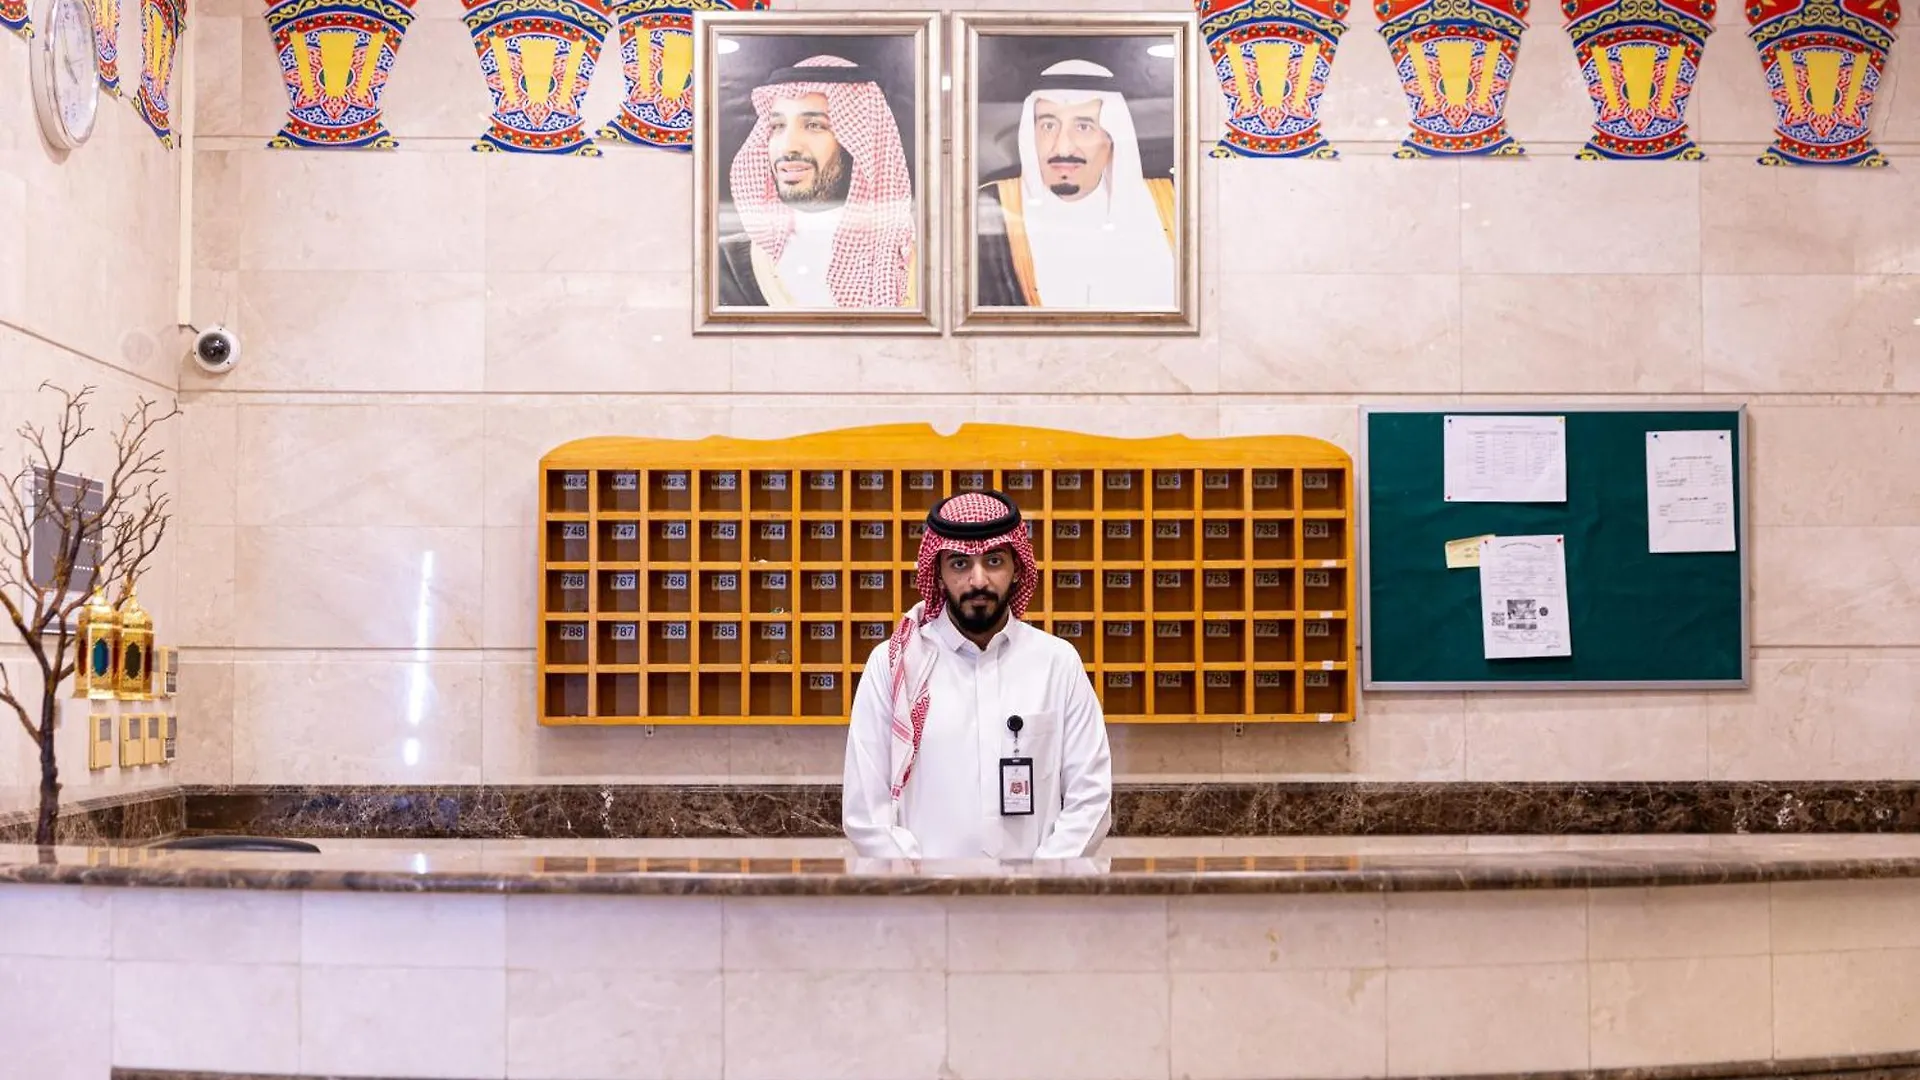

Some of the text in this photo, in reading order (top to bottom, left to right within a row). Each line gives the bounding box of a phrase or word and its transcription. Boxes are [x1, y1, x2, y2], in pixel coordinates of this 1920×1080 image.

[563, 525, 586, 537] 748
[613, 525, 636, 537] 747
[663, 525, 685, 537] 746
[712, 525, 735, 537] 745
[762, 525, 784, 537] 744
[811, 525, 834, 537] 743
[860, 525, 883, 537] 742
[1057, 525, 1079, 536] 736
[1107, 525, 1130, 536] 735
[1157, 525, 1179, 536] 734
[1206, 524, 1229, 535] 733
[1255, 524, 1278, 535] 732
[1305, 524, 1327, 535] 731
[562, 575, 584, 587] 768
[611, 575, 634, 587] 767
[663, 575, 685, 587] 766
[712, 575, 735, 587] 765
[762, 575, 784, 587] 764
[812, 575, 835, 586] 763
[860, 575, 883, 586] 762
[1057, 574, 1080, 586] 756
[1107, 574, 1130, 586] 755
[1157, 574, 1180, 586] 754
[1206, 573, 1229, 585] 753
[1256, 573, 1278, 585] 752
[1306, 573, 1328, 585] 751
[561, 625, 584, 637] 788
[611, 625, 634, 637] 787
[663, 625, 685, 637] 786
[713, 625, 735, 637] 785
[762, 625, 784, 637] 784
[811, 625, 834, 636] 783
[861, 625, 883, 636] 782
[1058, 623, 1081, 635] 776
[1158, 623, 1180, 635] 774
[1207, 623, 1229, 634] 773
[1256, 623, 1278, 634] 772
[1306, 623, 1327, 634] 771
[811, 675, 833, 687] 703
[1109, 673, 1132, 685] 795
[1158, 673, 1181, 685] 794
[1208, 673, 1230, 685] 793
[1256, 673, 1279, 685] 792
[1306, 673, 1328, 685] 791
